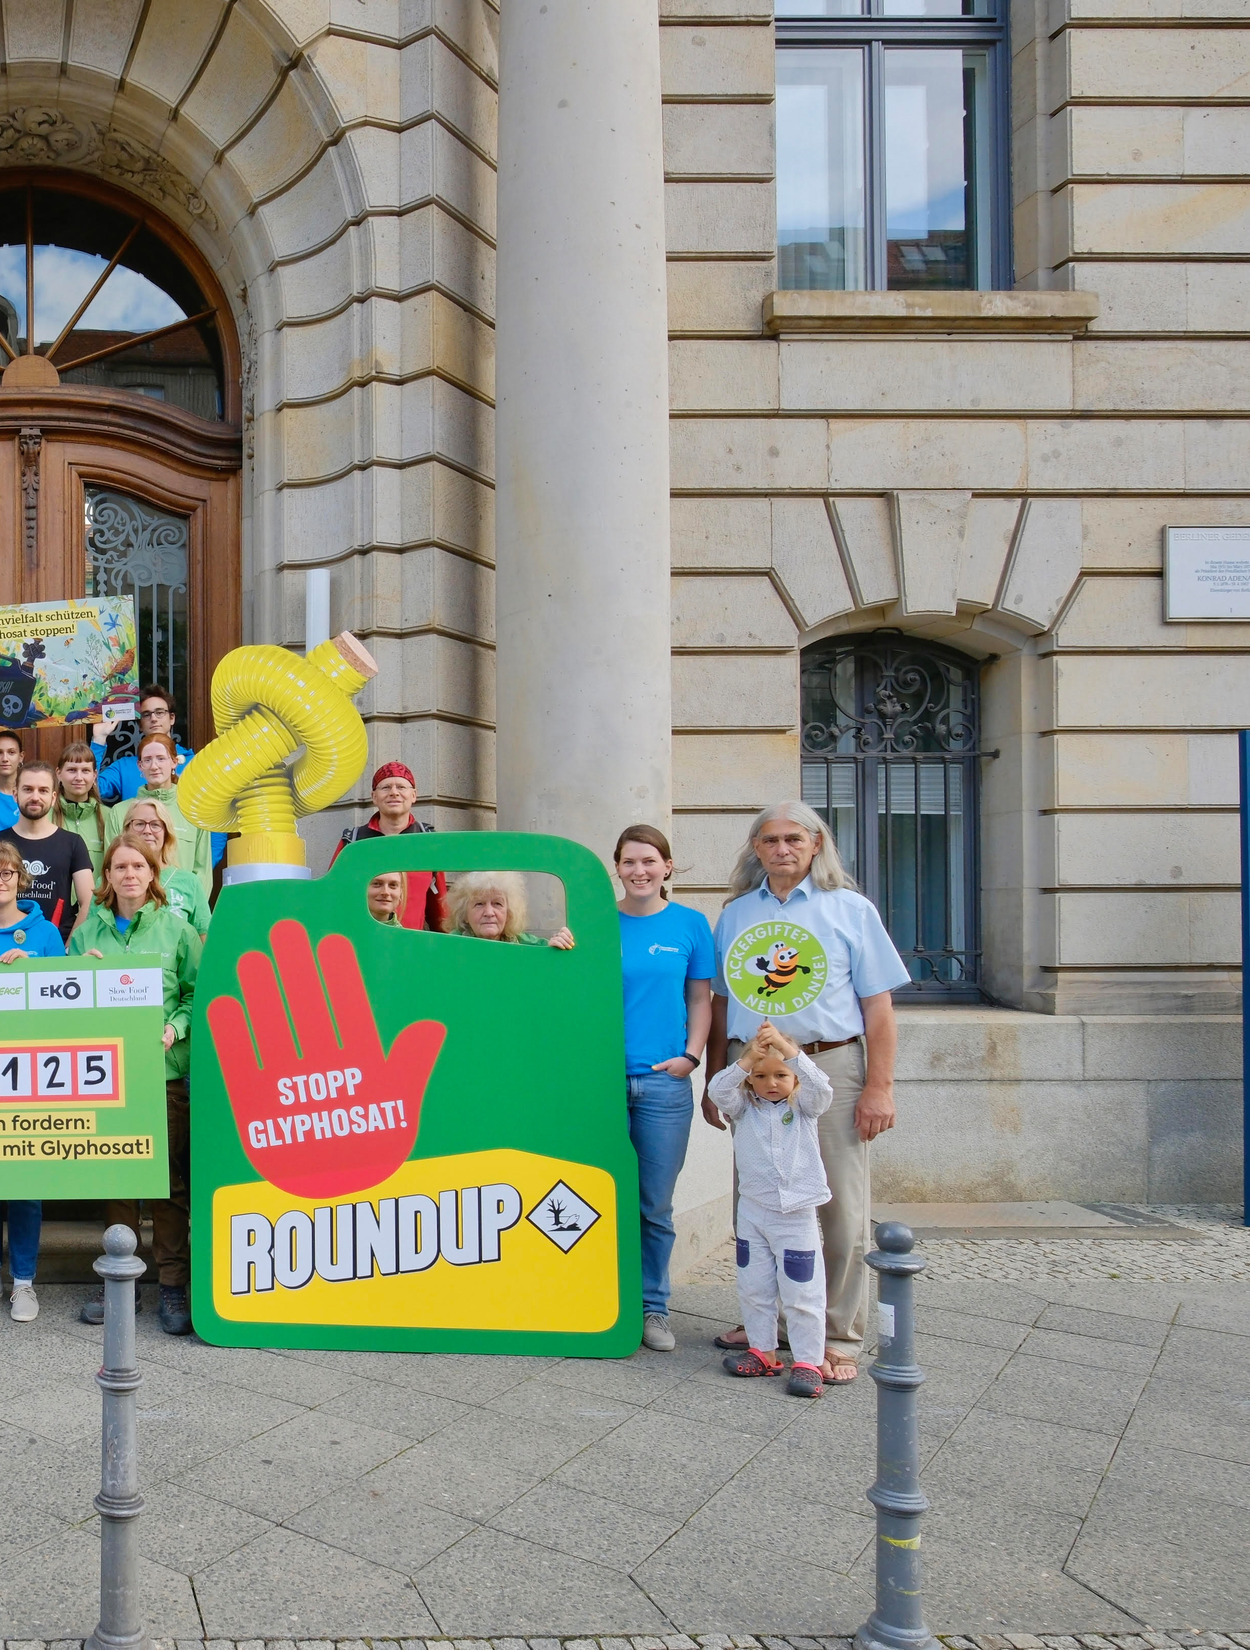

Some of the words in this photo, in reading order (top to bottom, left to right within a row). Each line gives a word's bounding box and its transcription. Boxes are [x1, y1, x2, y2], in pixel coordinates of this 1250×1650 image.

[29, 624, 76, 638] stoppen!
[45, 609, 97, 622] schützen,
[729, 923, 809, 981] ACKERGIFTE?
[745, 993, 786, 1014] NEIN
[792, 953, 826, 1010] DANKE!
[277, 1067, 363, 1106] STOPP
[11, 1113, 91, 1132] fordern:
[247, 1099, 408, 1149] GLYPHOSAT!
[2, 1140, 36, 1157] mit
[40, 1138, 150, 1160] Glyphosat!
[230, 1182, 523, 1297] ROUNDUP
